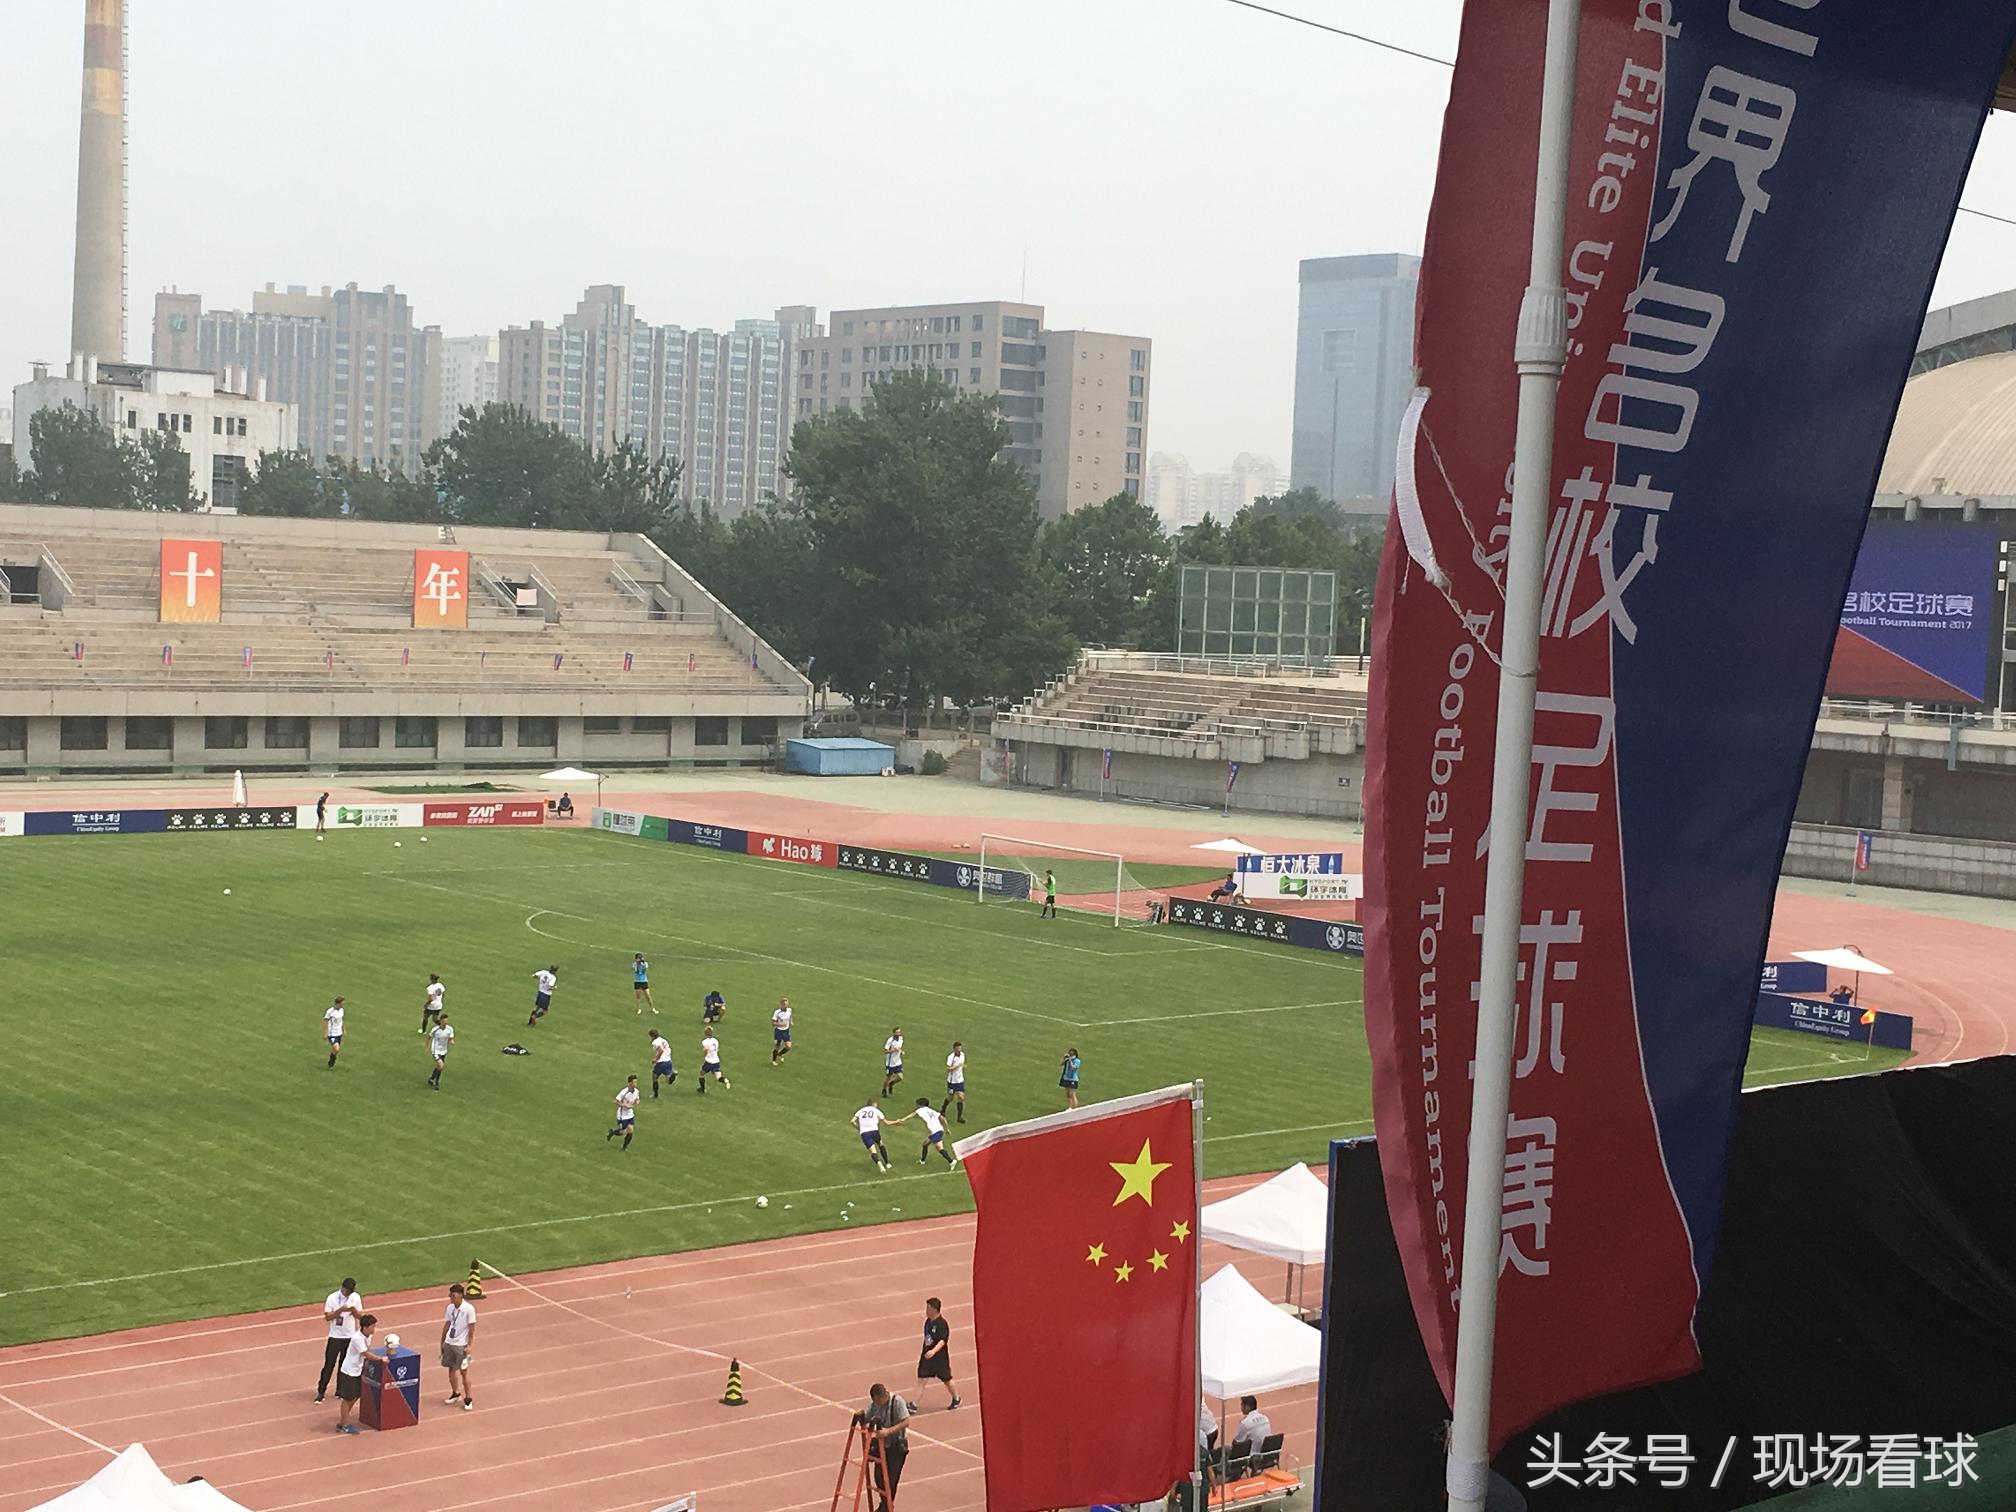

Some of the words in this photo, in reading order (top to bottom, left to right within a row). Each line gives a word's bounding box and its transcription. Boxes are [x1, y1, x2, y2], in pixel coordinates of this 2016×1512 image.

[1588, 58, 1664, 214] Elite
[169, 551, 215, 608] 十
[421, 562, 462, 616] 年
[1840, 616, 1876, 626] ootball
[1878, 617, 1947, 630] Tournament
[1949, 621, 1972, 630] 2017
[1423, 609, 1495, 868] Football
[1260, 855, 1320, 874] 恒大冰泉
[1790, 1002, 1850, 1023] 信中利
[862, 1110, 874, 1119] 20
[1418, 886, 1462, 1313] Tournament
